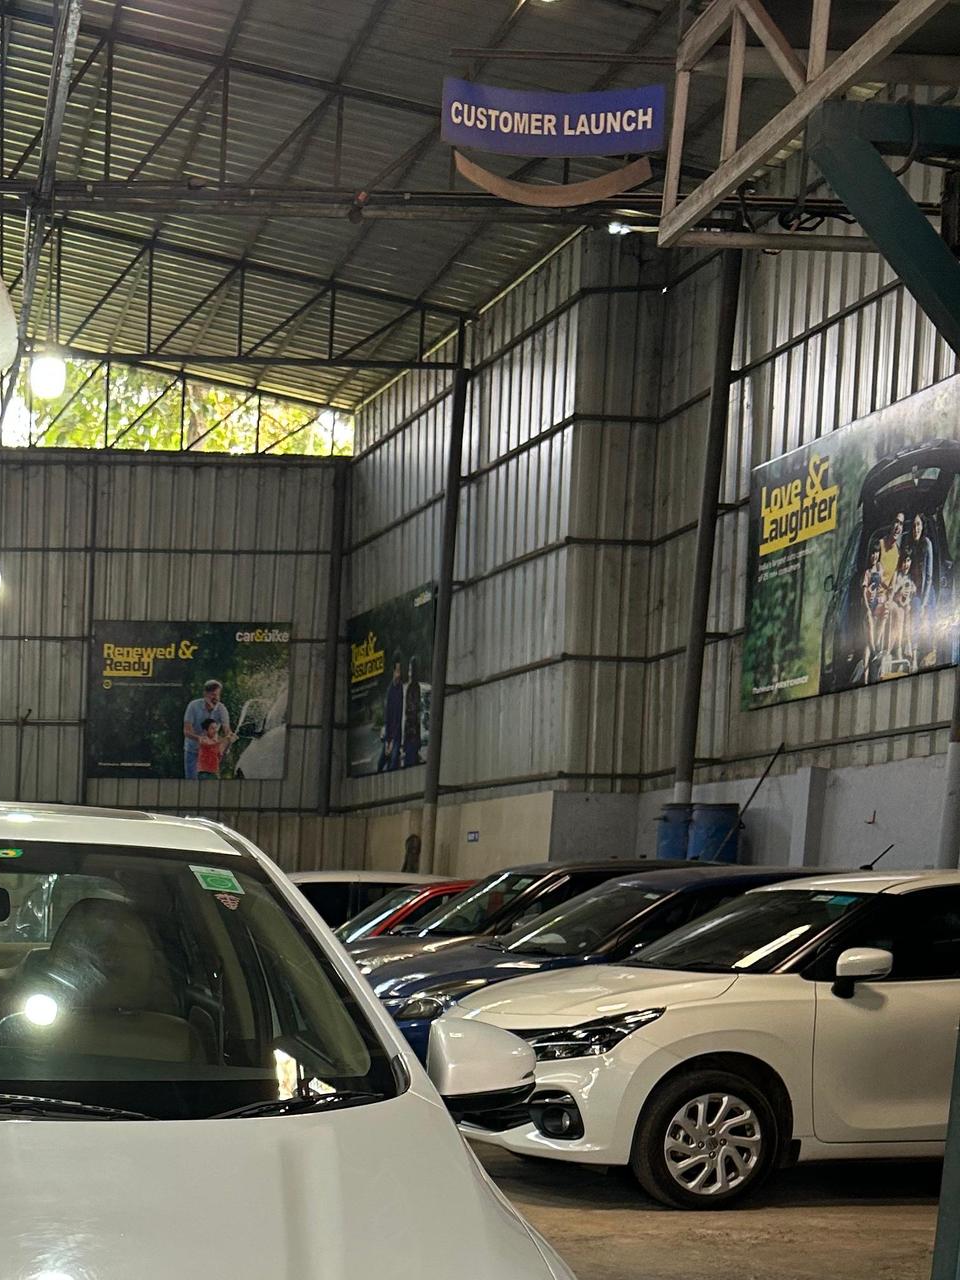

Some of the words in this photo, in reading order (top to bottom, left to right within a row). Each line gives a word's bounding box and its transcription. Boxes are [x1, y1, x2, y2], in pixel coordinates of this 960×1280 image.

[451, 101, 556, 136] CUSTOMER
[563, 108, 652, 136] LAUNCH
[761, 479, 801, 513] Love
[806, 454, 829, 497] &
[760, 494, 837, 545] Laughter
[235, 629, 289, 643] car&bike
[103, 643, 176, 660] Renewed
[178, 640, 199, 660] &
[104, 658, 151, 676] Ready
